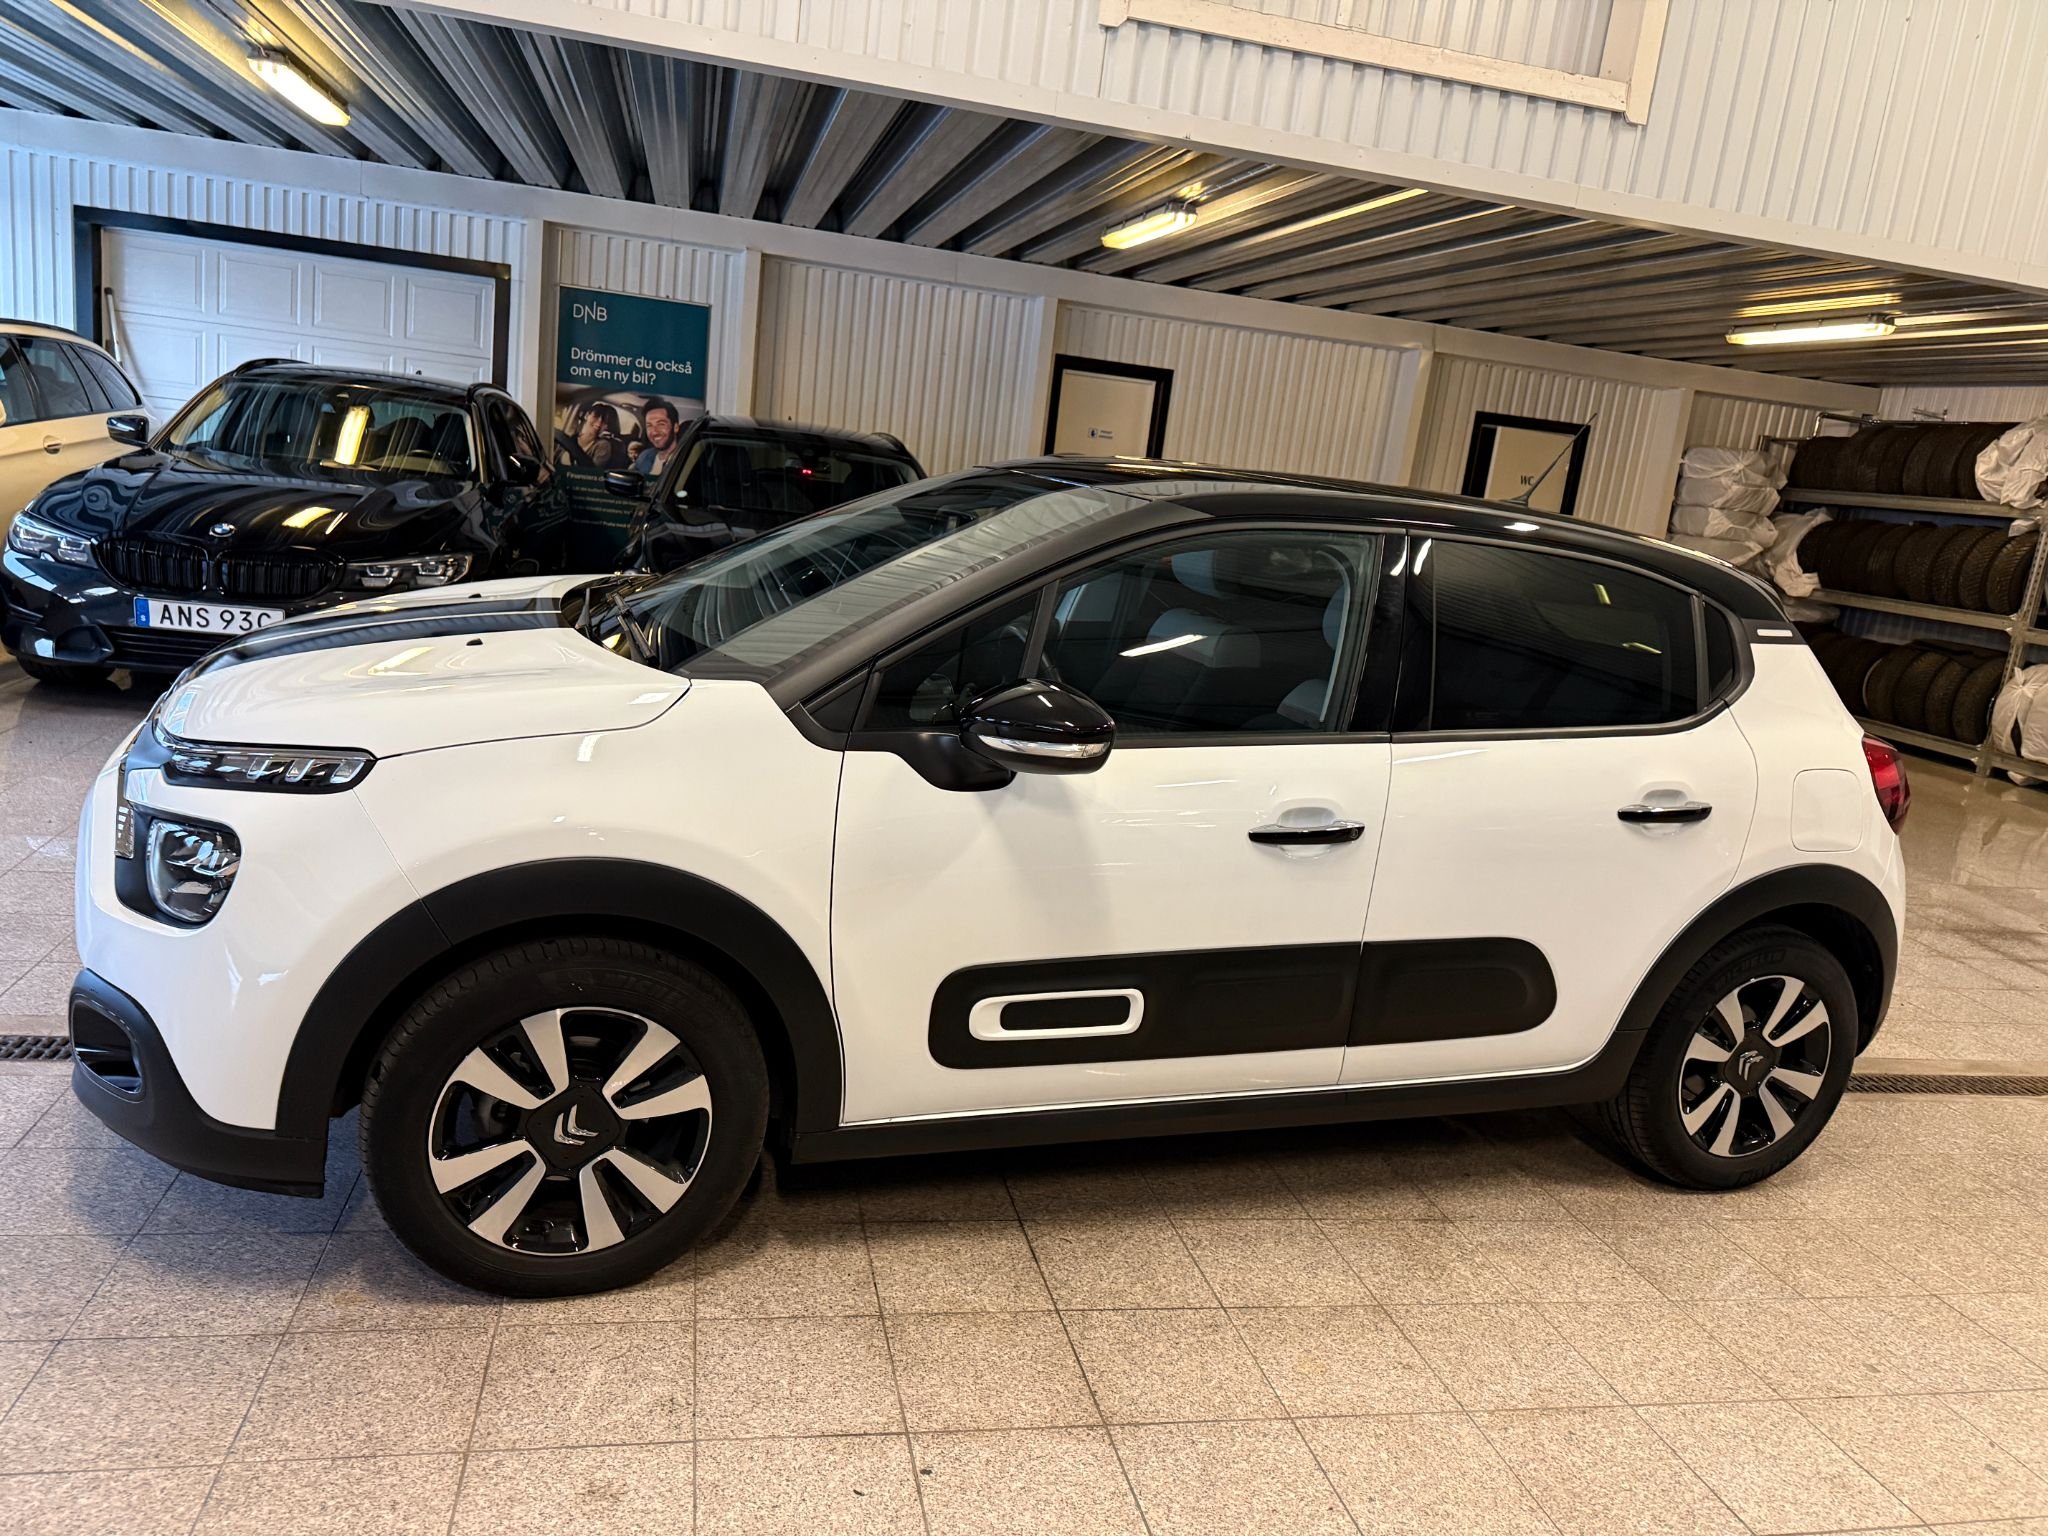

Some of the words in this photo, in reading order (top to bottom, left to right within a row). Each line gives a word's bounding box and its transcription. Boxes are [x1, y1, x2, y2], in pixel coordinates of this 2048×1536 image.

[573, 301, 608, 324] DNB
[571, 347, 632, 366] Drömmer
[635, 356, 652, 369] du
[655, 360, 692, 374] också
[570, 366, 591, 377] om
[594, 368, 610, 380] en
[614, 371, 629, 384] ny
[632, 371, 656, 385] bil?
[160, 604, 210, 628] ANS
